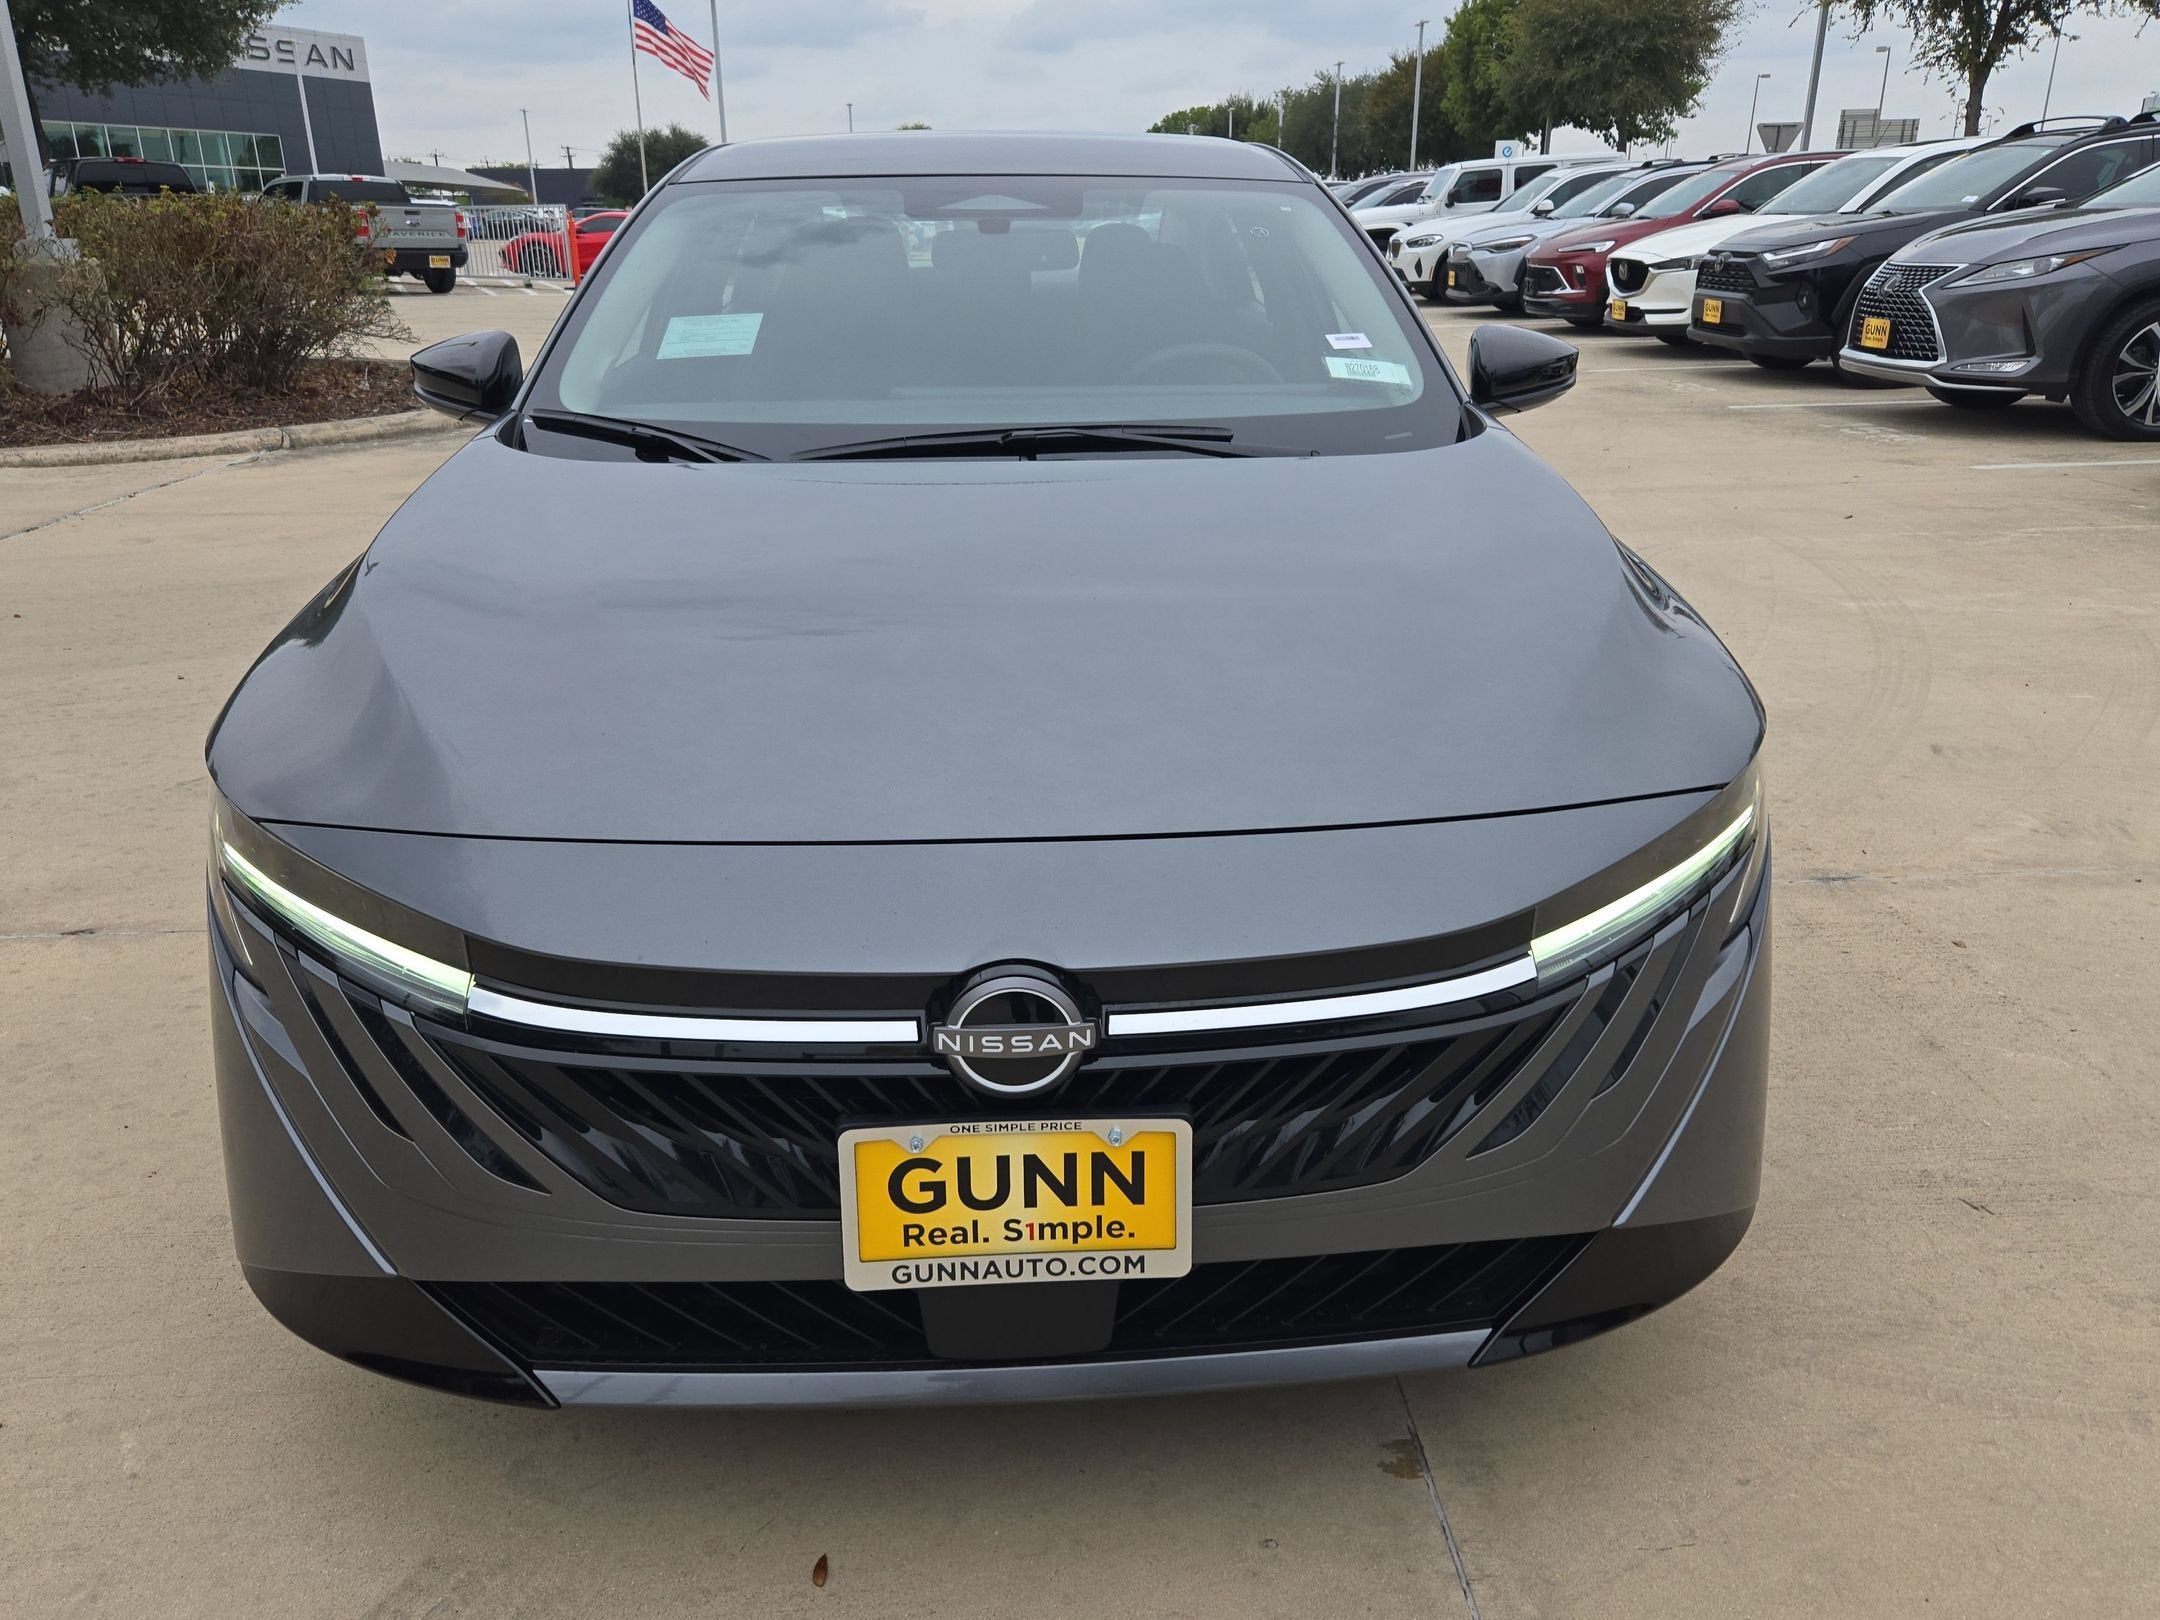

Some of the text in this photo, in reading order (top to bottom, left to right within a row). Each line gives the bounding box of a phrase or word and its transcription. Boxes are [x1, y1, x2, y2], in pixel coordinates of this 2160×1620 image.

[246, 35, 355, 71] SSAN
[1705, 302, 1720, 313] GUNN
[1865, 323, 1888, 337] GUNN
[937, 1029, 1091, 1053] NISSAN
[949, 1121, 1083, 1134] ONE SIMPLE PRICE
[887, 1150, 1145, 1215] GUNN
[902, 1218, 990, 1248] Real.
[891, 1254, 1145, 1285] GUNNAUTO.COM
